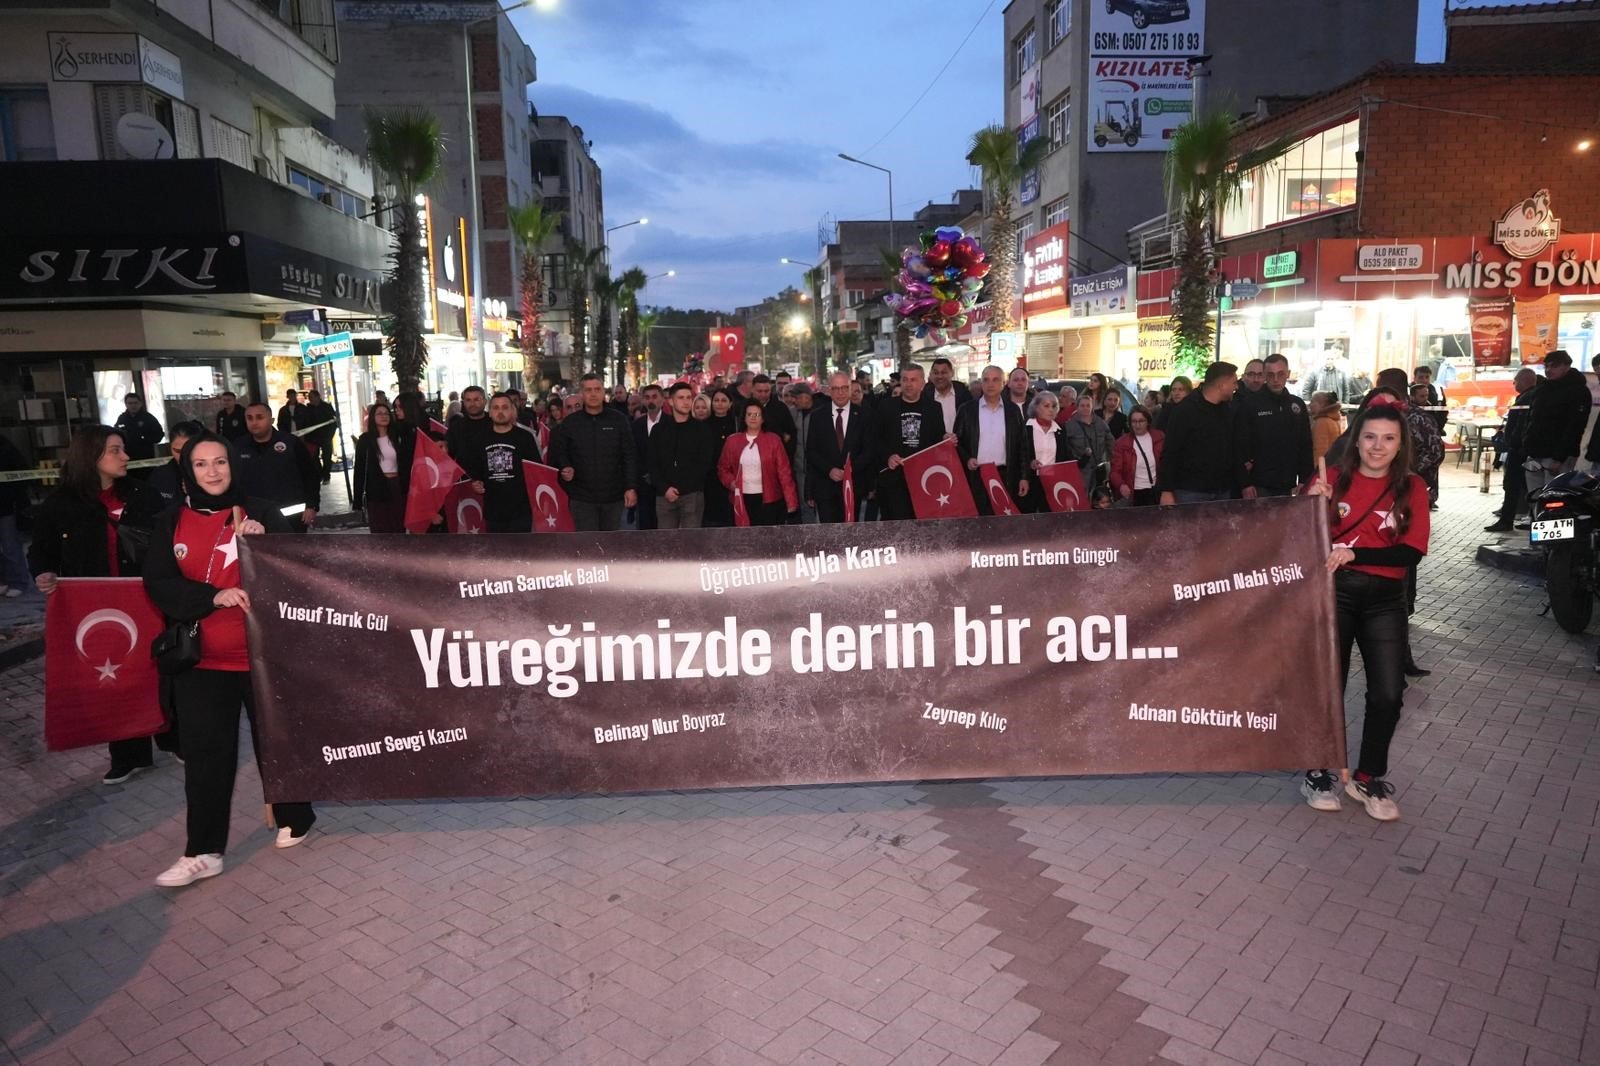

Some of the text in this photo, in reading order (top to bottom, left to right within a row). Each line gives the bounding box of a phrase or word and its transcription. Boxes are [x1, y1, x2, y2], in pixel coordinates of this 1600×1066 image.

[1094, 32, 1200, 50] GSM: 0507 275 18 93
[1363, 258, 1381, 268] 0535
[1374, 247, 1408, 257] ALO PAKET
[1072, 280, 1095, 297] DENİZ
[1533, 520, 1573, 530] 45 ATH
[1543, 530, 1562, 539] 705
[699, 545, 898, 595] Öğretmen Ayla Kara
[971, 546, 1120, 569] Kerem Erdem Güngör
[459, 565, 609, 599] Furkan Sancak Balal
[1173, 562, 1304, 601] Bayram Nabi Şişik
[278, 601, 389, 632] Yusuf Tarık Gül
[410, 604, 1179, 698] Yüreğimizde derin bir acı...
[594, 711, 727, 745] Belinay Nur Boyraz
[923, 702, 1008, 734] Zeynep Kılıç
[1129, 702, 1277, 731] Adnan Göktürk Yeşil
[322, 726, 468, 765] Şuranur Sevgi Kazıcı
